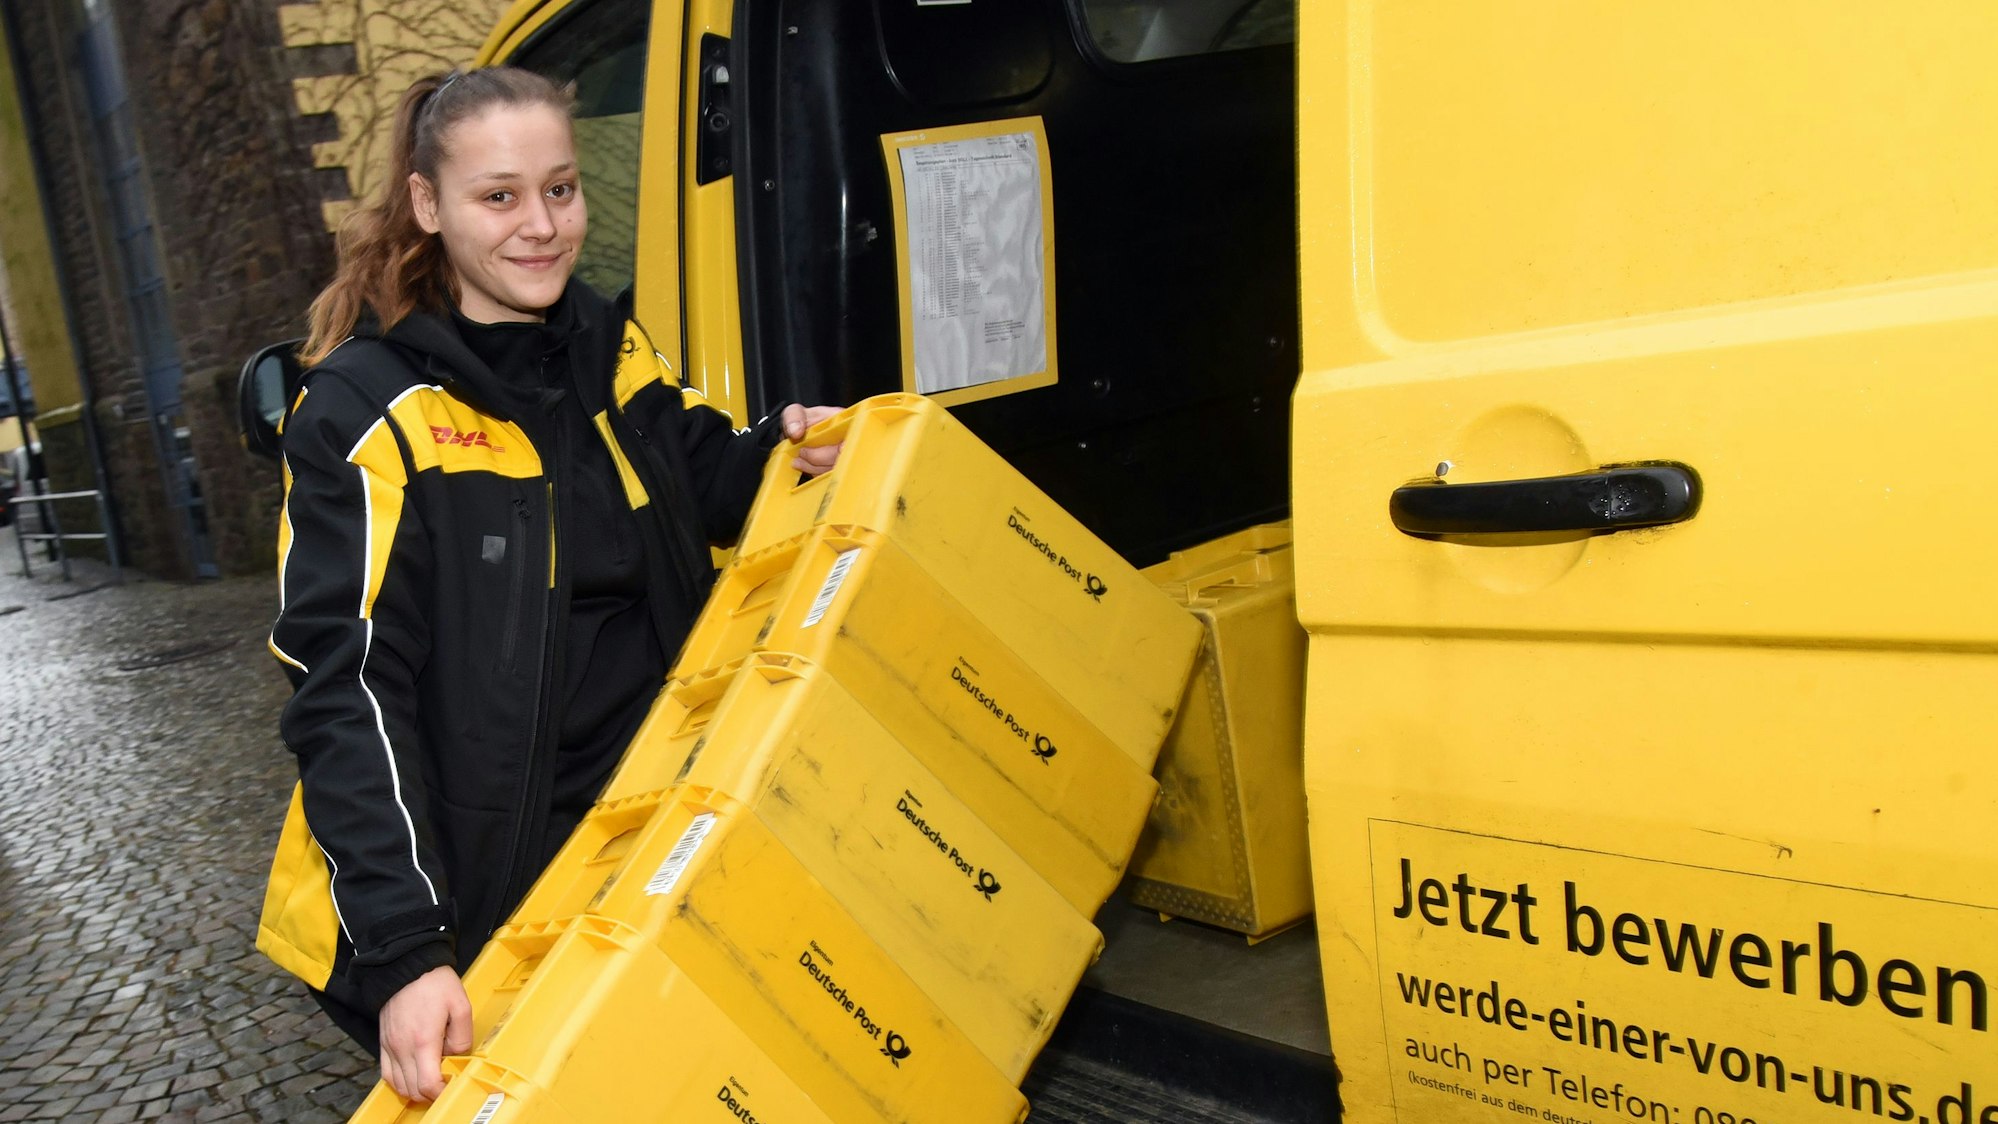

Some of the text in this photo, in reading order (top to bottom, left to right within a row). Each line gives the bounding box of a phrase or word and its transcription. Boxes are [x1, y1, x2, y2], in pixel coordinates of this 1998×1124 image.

[429, 425, 492, 447] DHL
[1007, 514, 1057, 561] Deutsche
[1058, 556, 1082, 582] Post
[951, 666, 1030, 742] Deutsche Post
[896, 797, 948, 853] Deutsche
[948, 847, 974, 878] Post
[809, 940, 834, 966] Eigentum
[1393, 858, 1988, 1033] Jetzt bewerben
[799, 950, 882, 1040] Deutsche Post
[1405, 1037, 1472, 1072] auch
[1483, 1057, 1533, 1088] per
[1408, 1070, 1477, 1101] (kostenfrei
[1481, 1093, 1504, 1108] aus
[1508, 1099, 1538, 1118] dem
